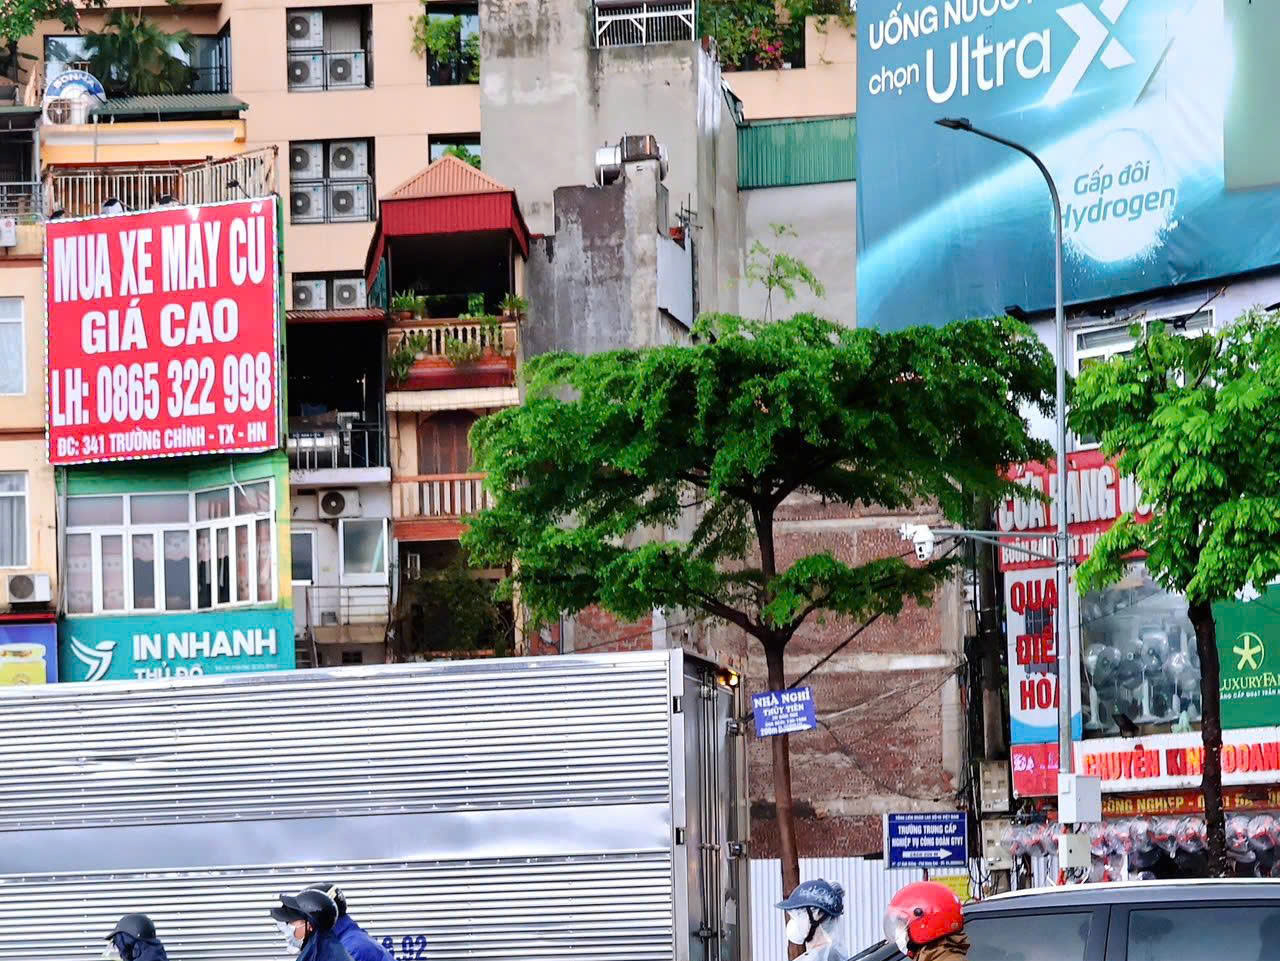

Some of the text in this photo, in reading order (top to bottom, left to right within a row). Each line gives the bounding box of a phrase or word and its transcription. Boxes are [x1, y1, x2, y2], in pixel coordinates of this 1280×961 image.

[869, 2, 940, 50] UỐNG
[869, 63, 919, 95] chọn
[926, 28, 1051, 103] Ultra
[1074, 160, 1150, 195] Gấp đôi
[1052, 187, 1176, 232] Hydrogen
[53, 232, 113, 303] MUA
[119, 228, 154, 297] XE
[229, 203, 266, 286] CŨ
[81, 298, 239, 354] GIÁ CAO
[52, 352, 271, 427] LH: 0865 322 998
[57, 434, 79, 456] ĐC:
[82, 434, 105, 454] 341
[109, 426, 161, 453] TRƯỜNG
[218, 424, 235, 445] TX
[247, 421, 267, 442] HN
[1010, 577, 1060, 617] QUẠ
[132, 628, 277, 662] IN NHANH
[753, 692, 780, 708] NHÀ
[1083, 744, 1161, 781] CHUYÊN
[1166, 746, 1205, 777] KIN
